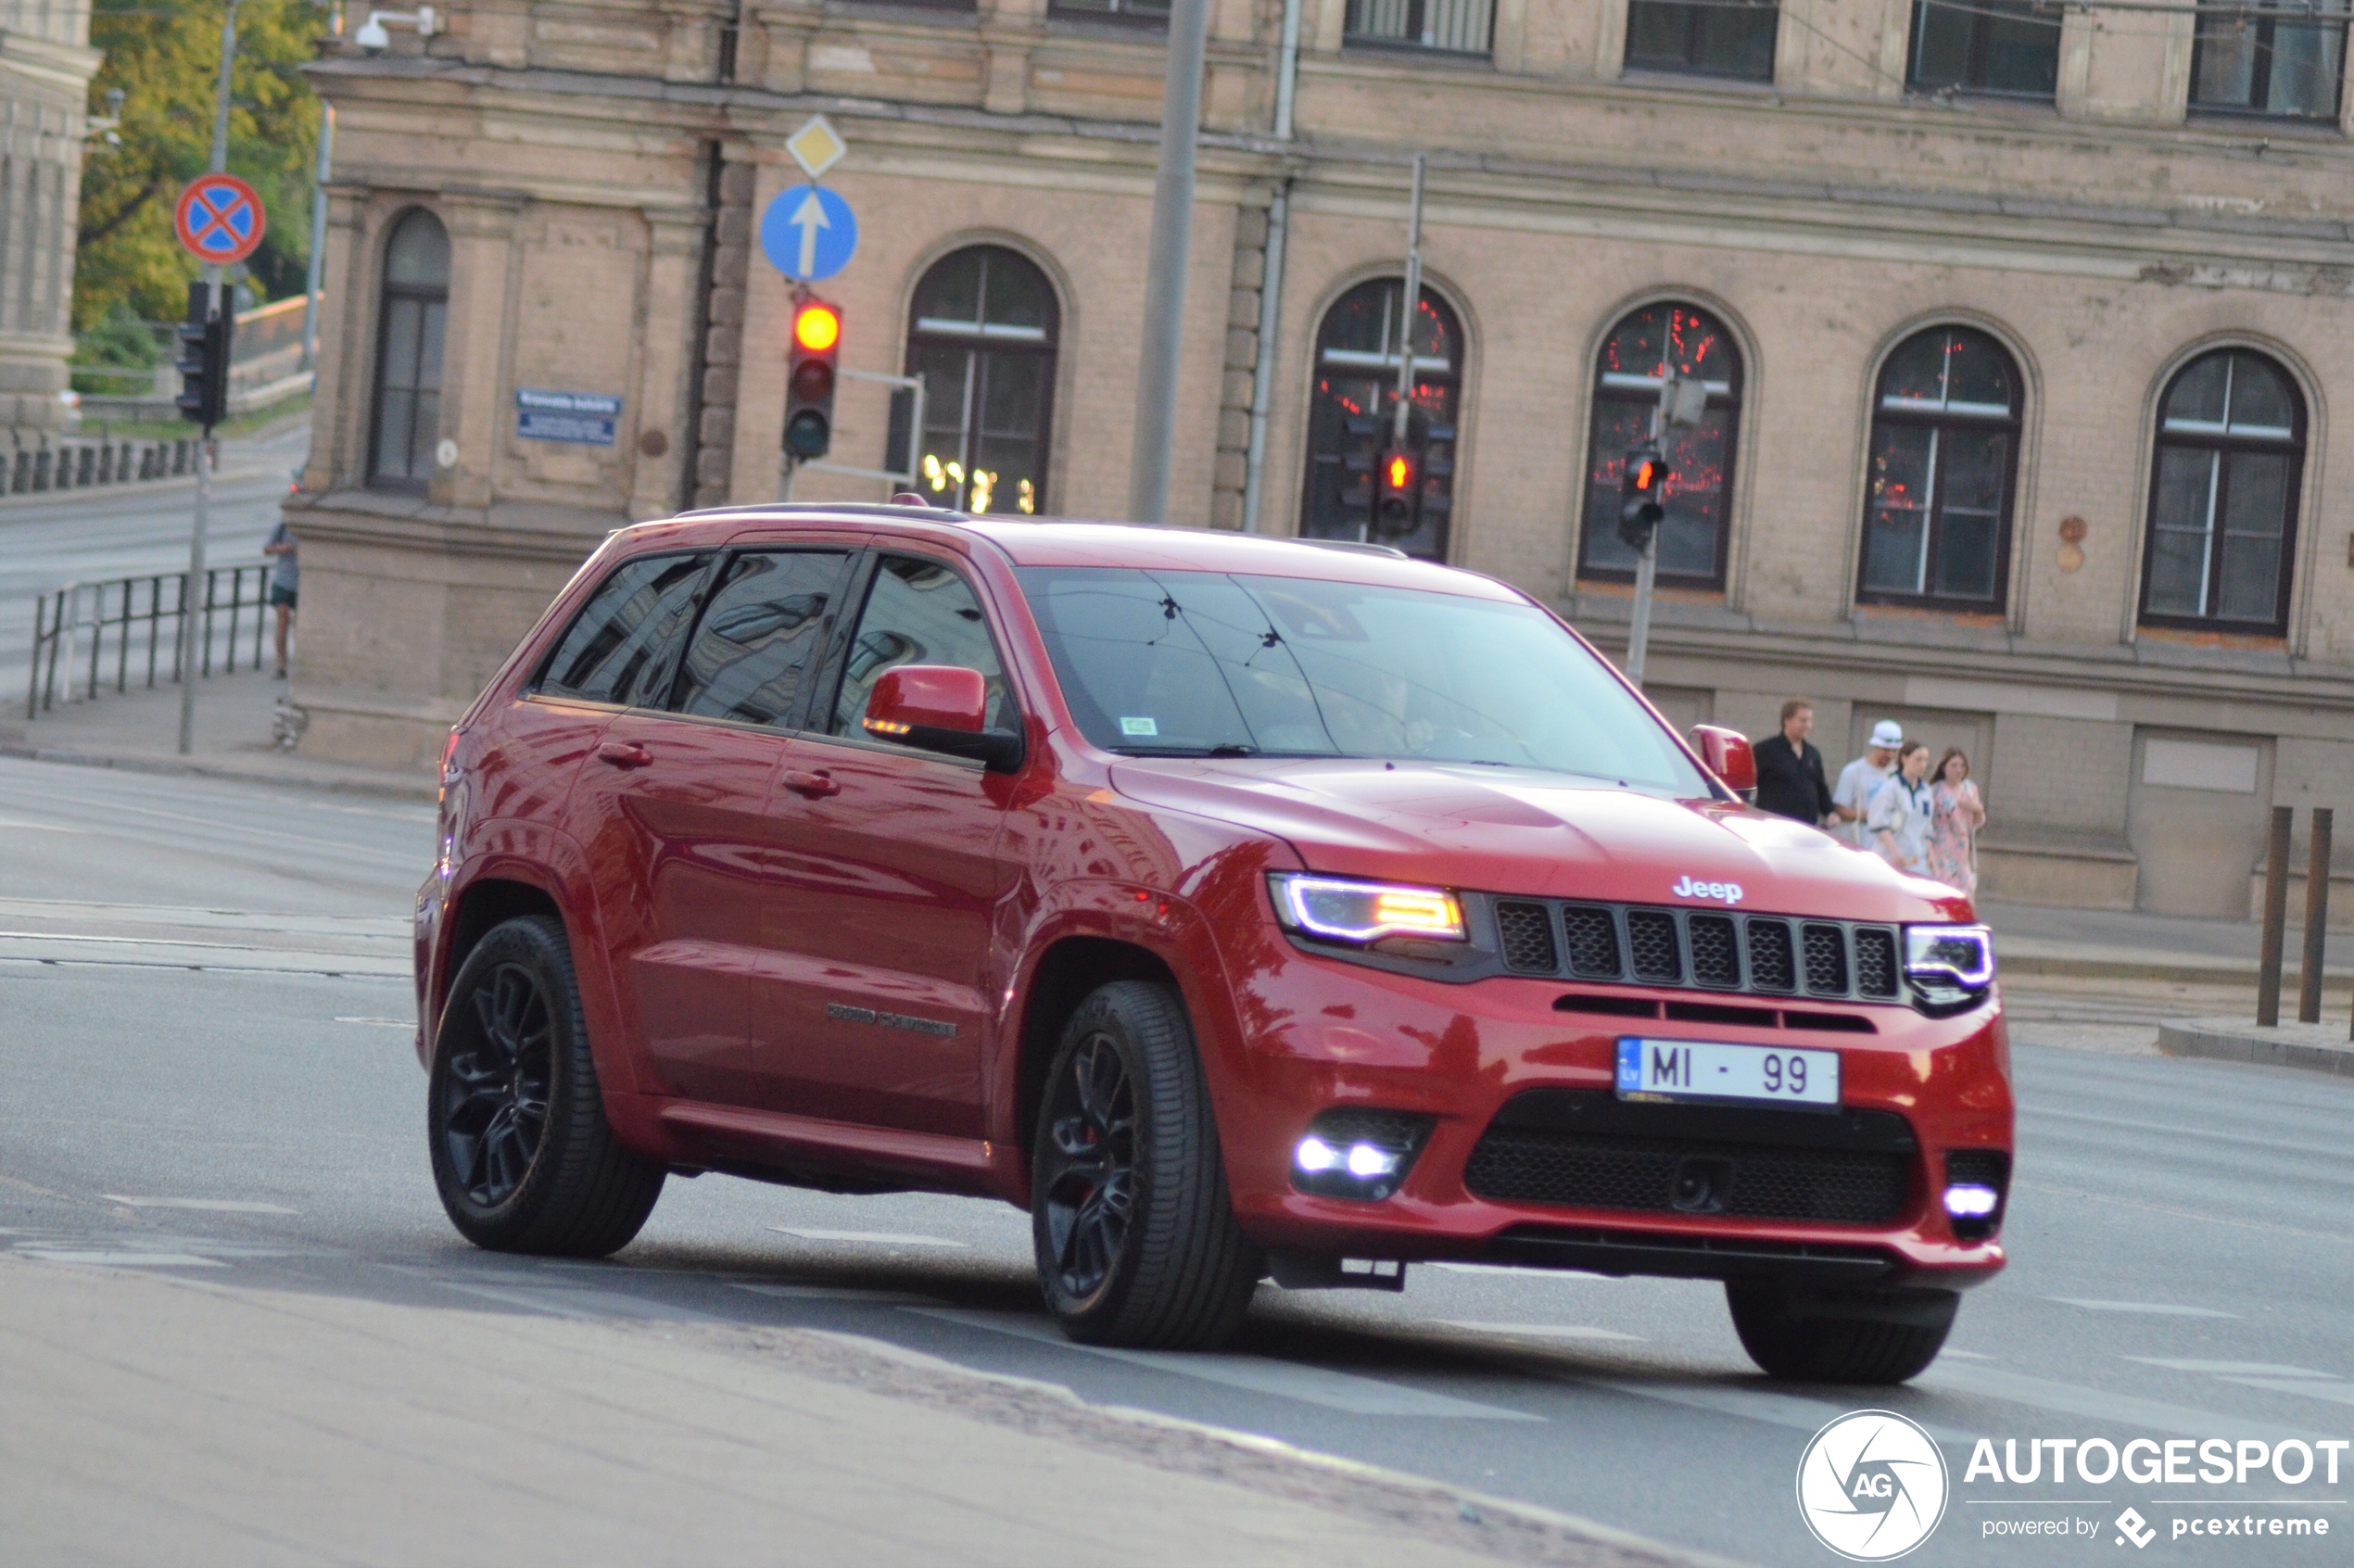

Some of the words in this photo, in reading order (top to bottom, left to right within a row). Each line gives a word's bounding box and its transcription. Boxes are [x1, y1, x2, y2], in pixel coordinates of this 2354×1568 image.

[1672, 875, 1742, 904] Jeep
[1622, 1069, 1639, 1081] LV
[1652, 1046, 1690, 1087] MI
[1764, 1054, 1806, 1094] 99
